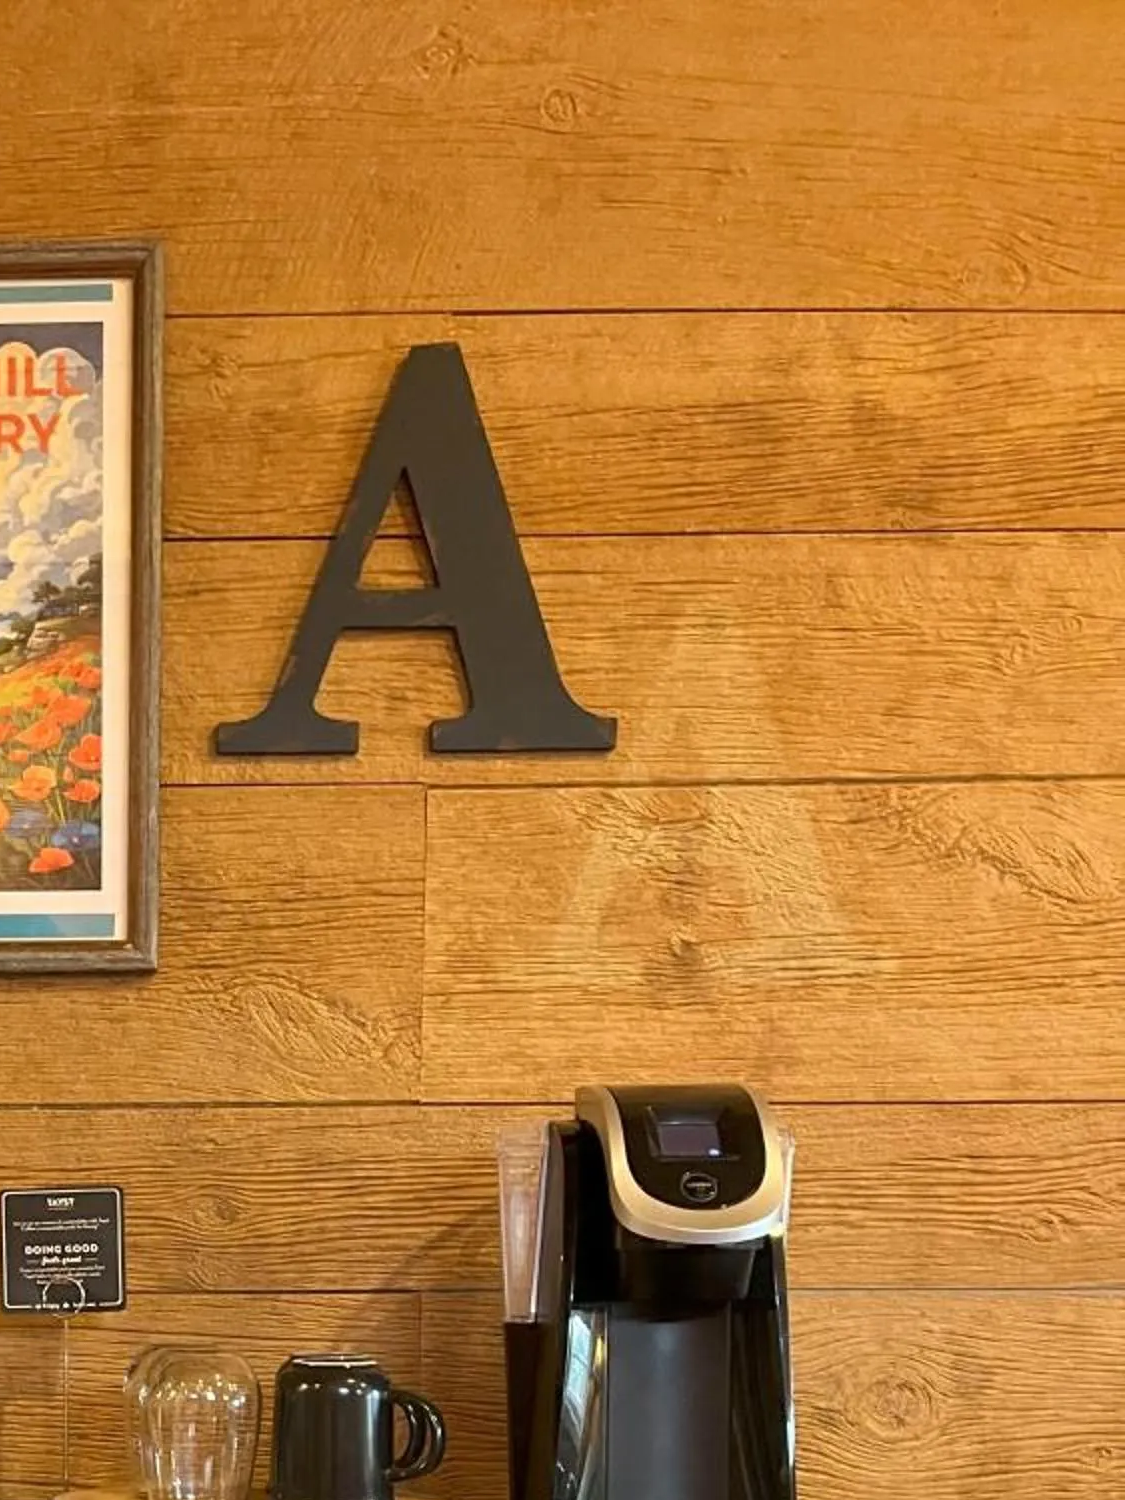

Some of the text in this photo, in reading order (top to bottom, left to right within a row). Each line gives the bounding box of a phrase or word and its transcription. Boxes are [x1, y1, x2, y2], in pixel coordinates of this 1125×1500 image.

[216, 342, 617, 755] A
[24, 1243, 99, 1255] DOING GOOD
